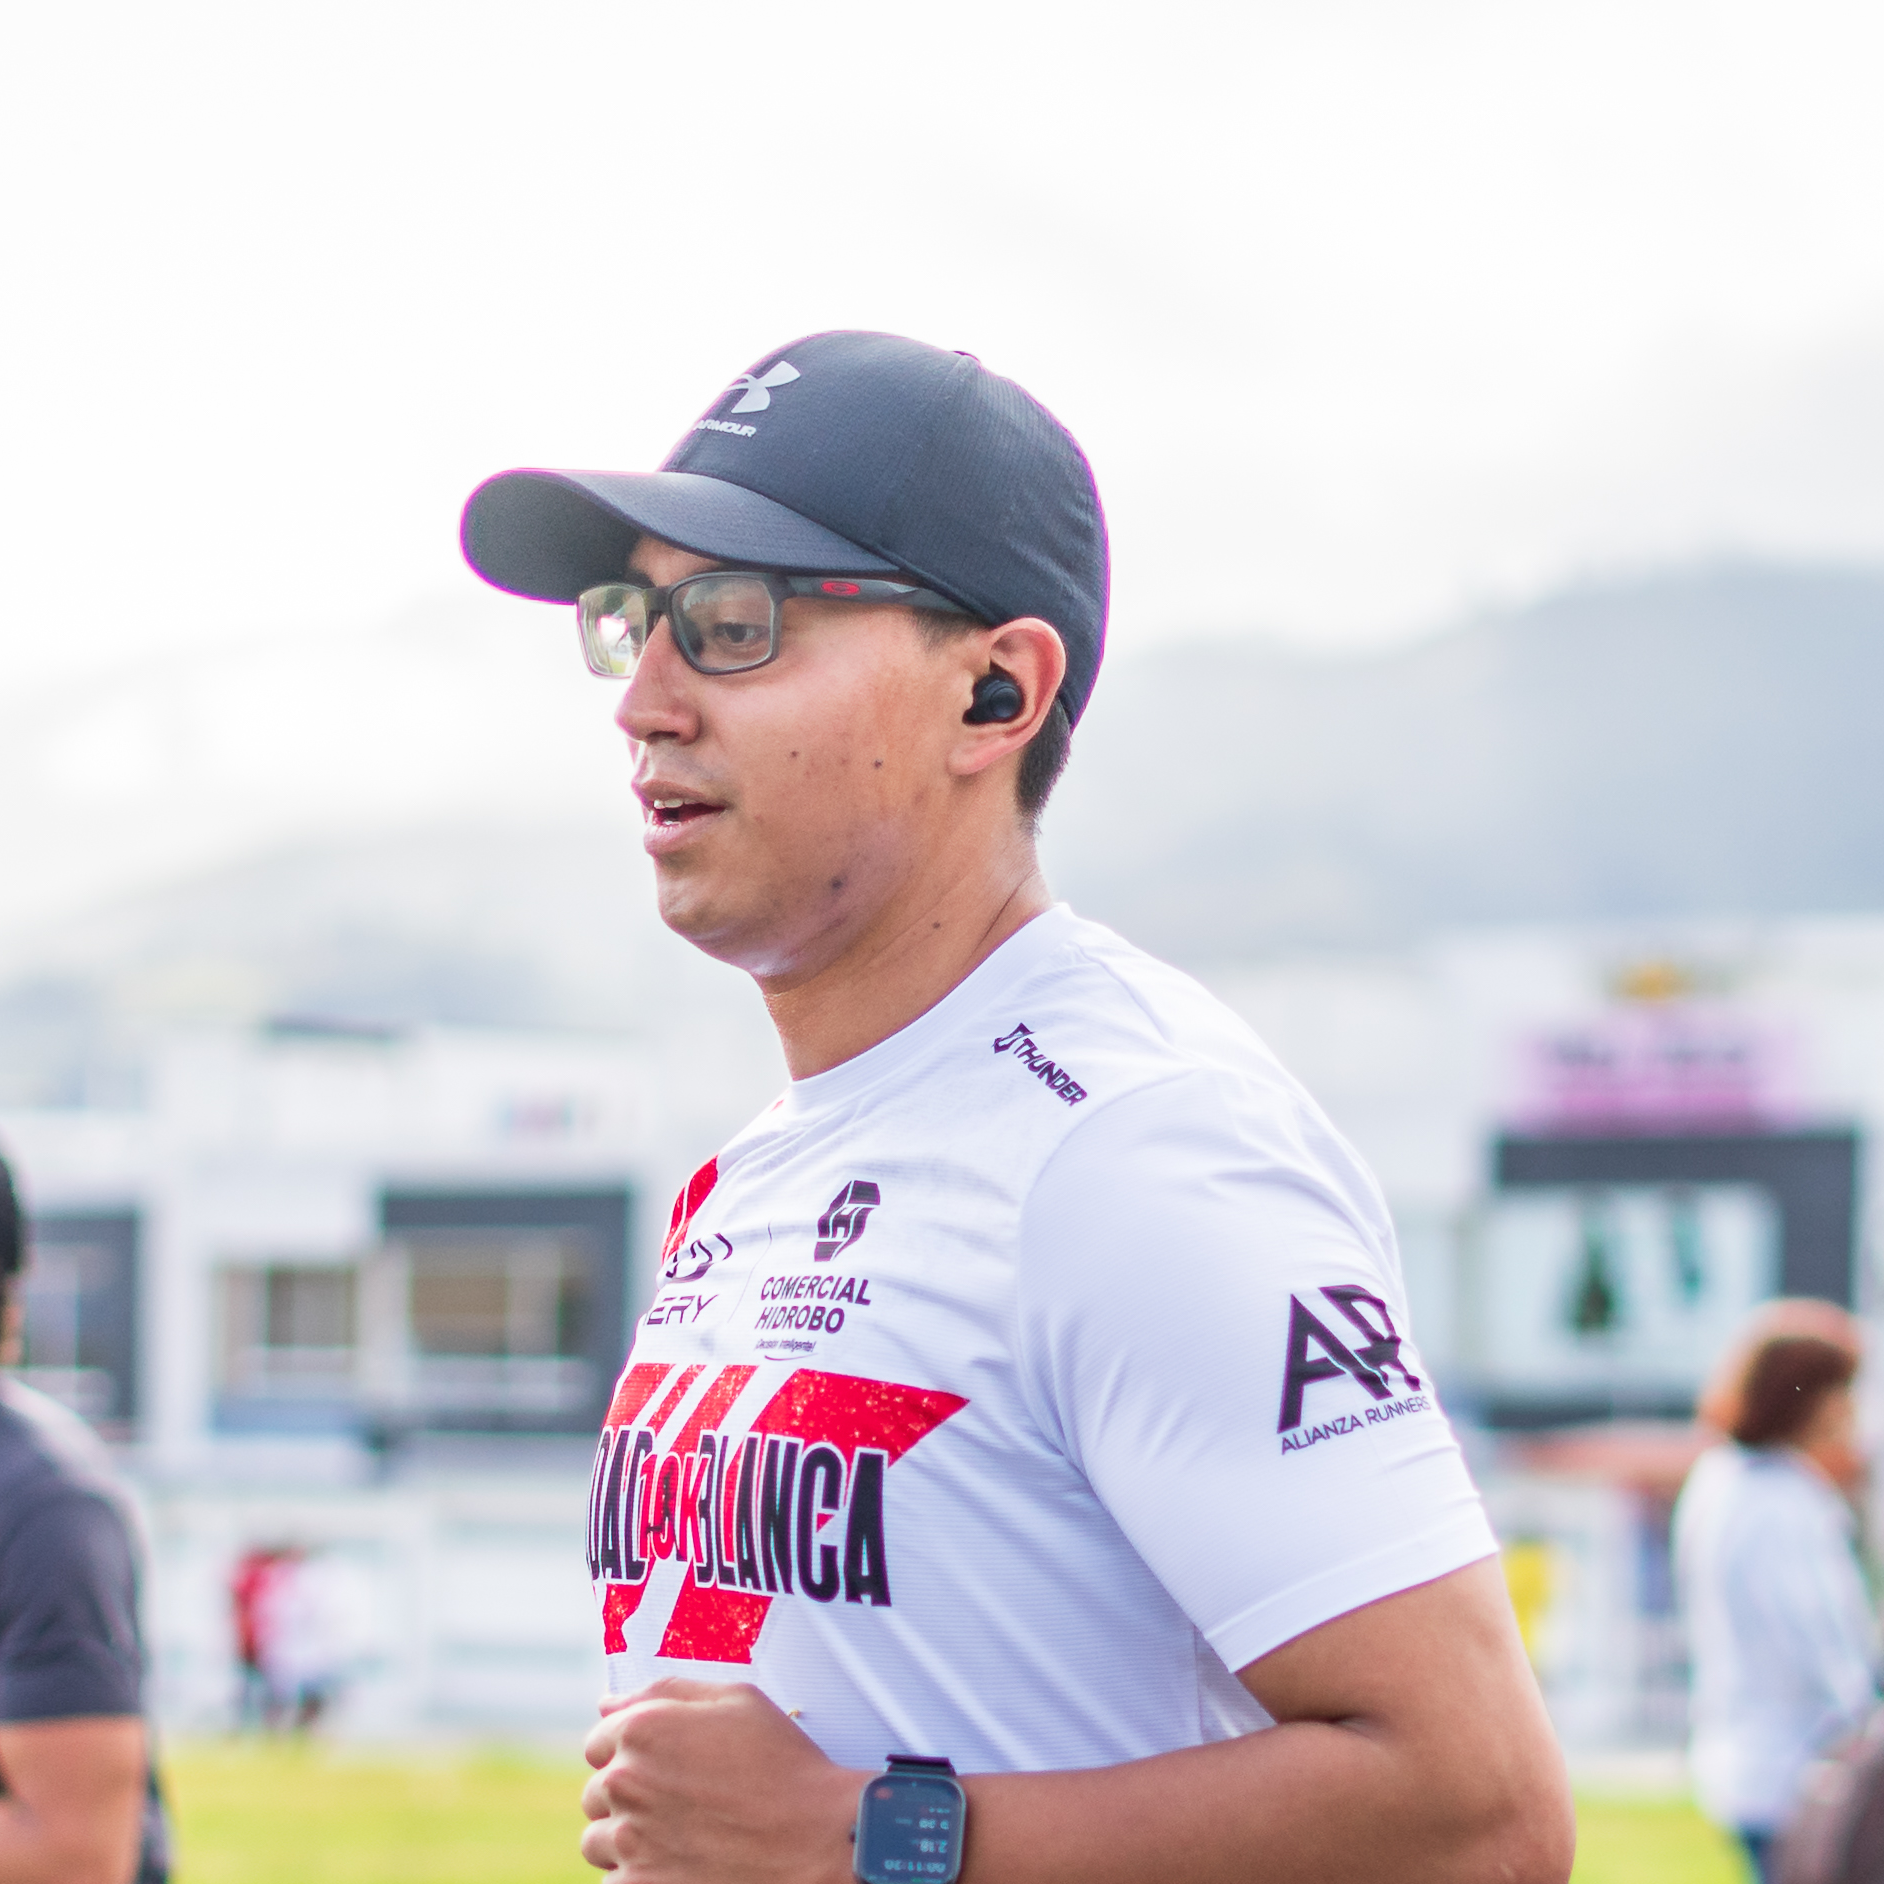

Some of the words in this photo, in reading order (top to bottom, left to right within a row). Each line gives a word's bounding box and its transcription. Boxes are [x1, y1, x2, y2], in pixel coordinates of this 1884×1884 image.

[1013, 1037, 1088, 1107] THUNDER
[760, 1275, 871, 1306] COMERCIAL
[754, 1304, 845, 1334] HIDROBO
[1281, 1413, 1364, 1456] ALIANZA
[1365, 1395, 1432, 1425] RUNNERS
